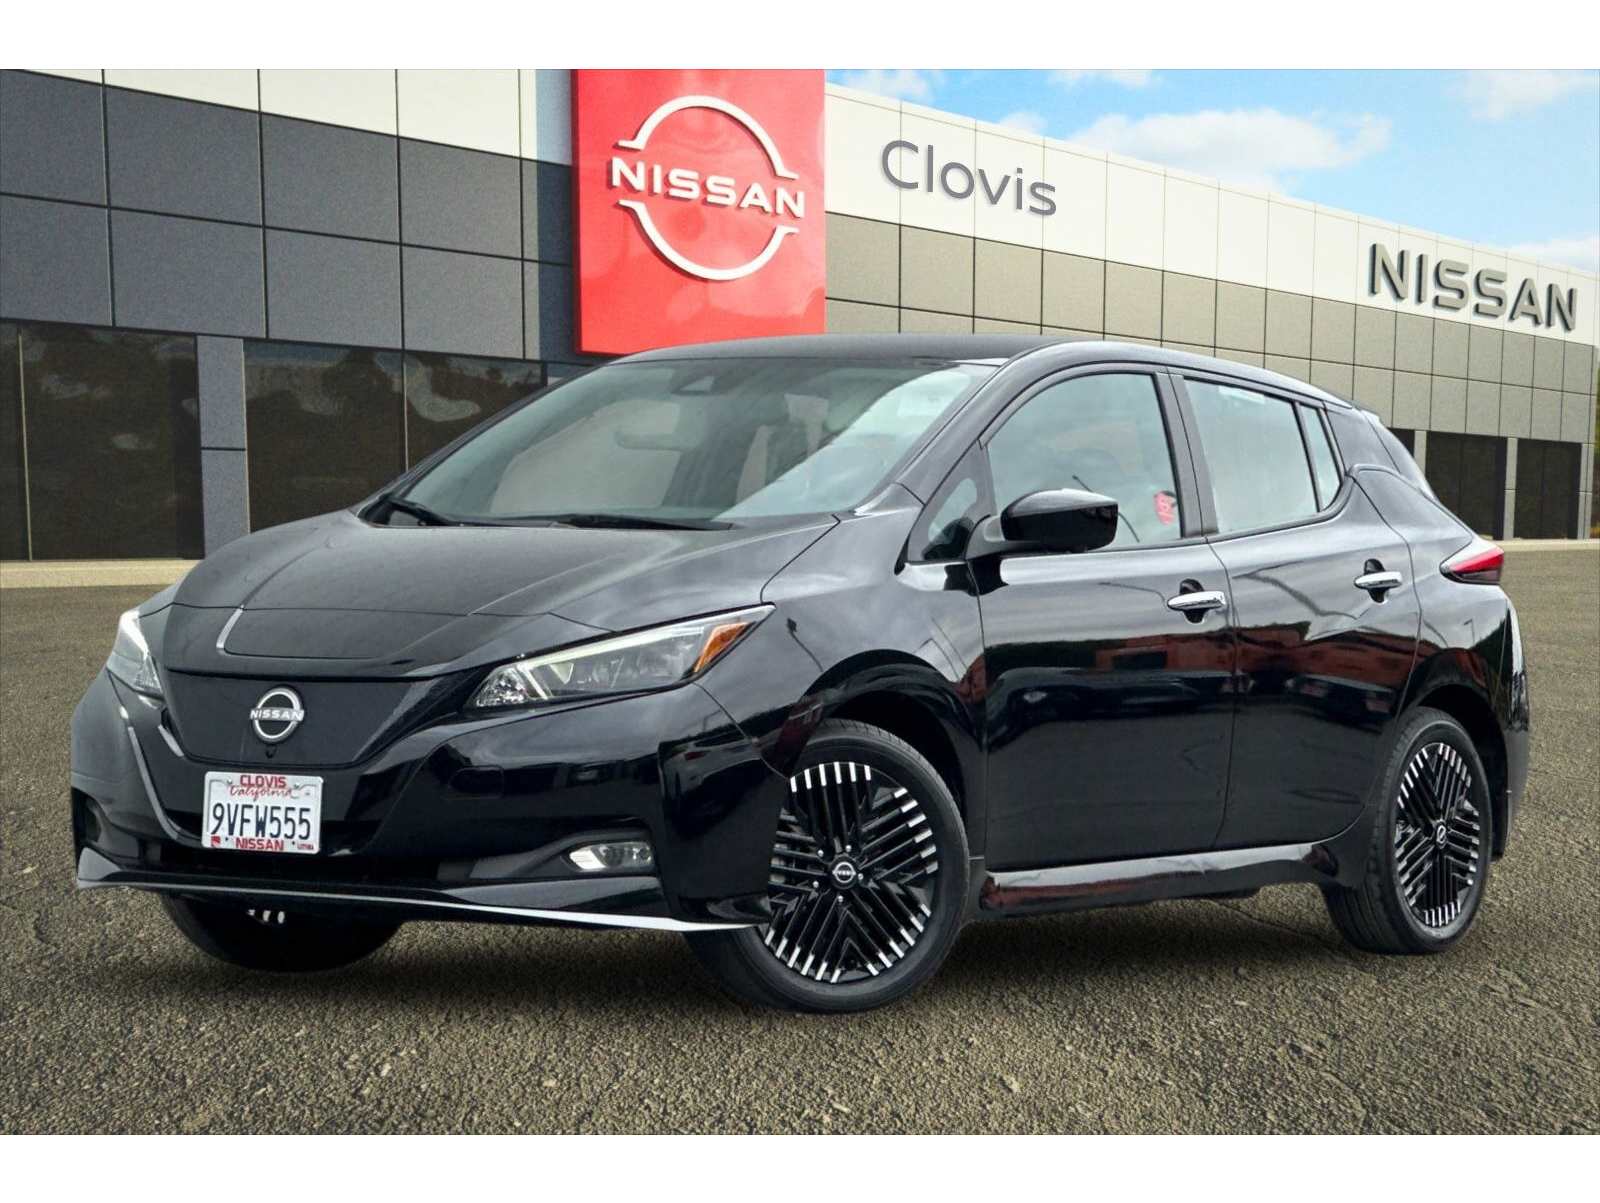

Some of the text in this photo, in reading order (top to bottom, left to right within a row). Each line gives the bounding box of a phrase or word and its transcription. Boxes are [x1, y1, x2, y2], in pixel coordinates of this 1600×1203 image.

[610, 156, 804, 219] NISSAN
[881, 139, 1057, 216] Clovis
[1368, 243, 1577, 331] NISSAN
[250, 708, 304, 721] NISSAN
[230, 785, 298, 801] California
[240, 774, 287, 788] CLOVIS
[211, 802, 311, 840] 9VFW555
[235, 837, 284, 850] NISSAN
